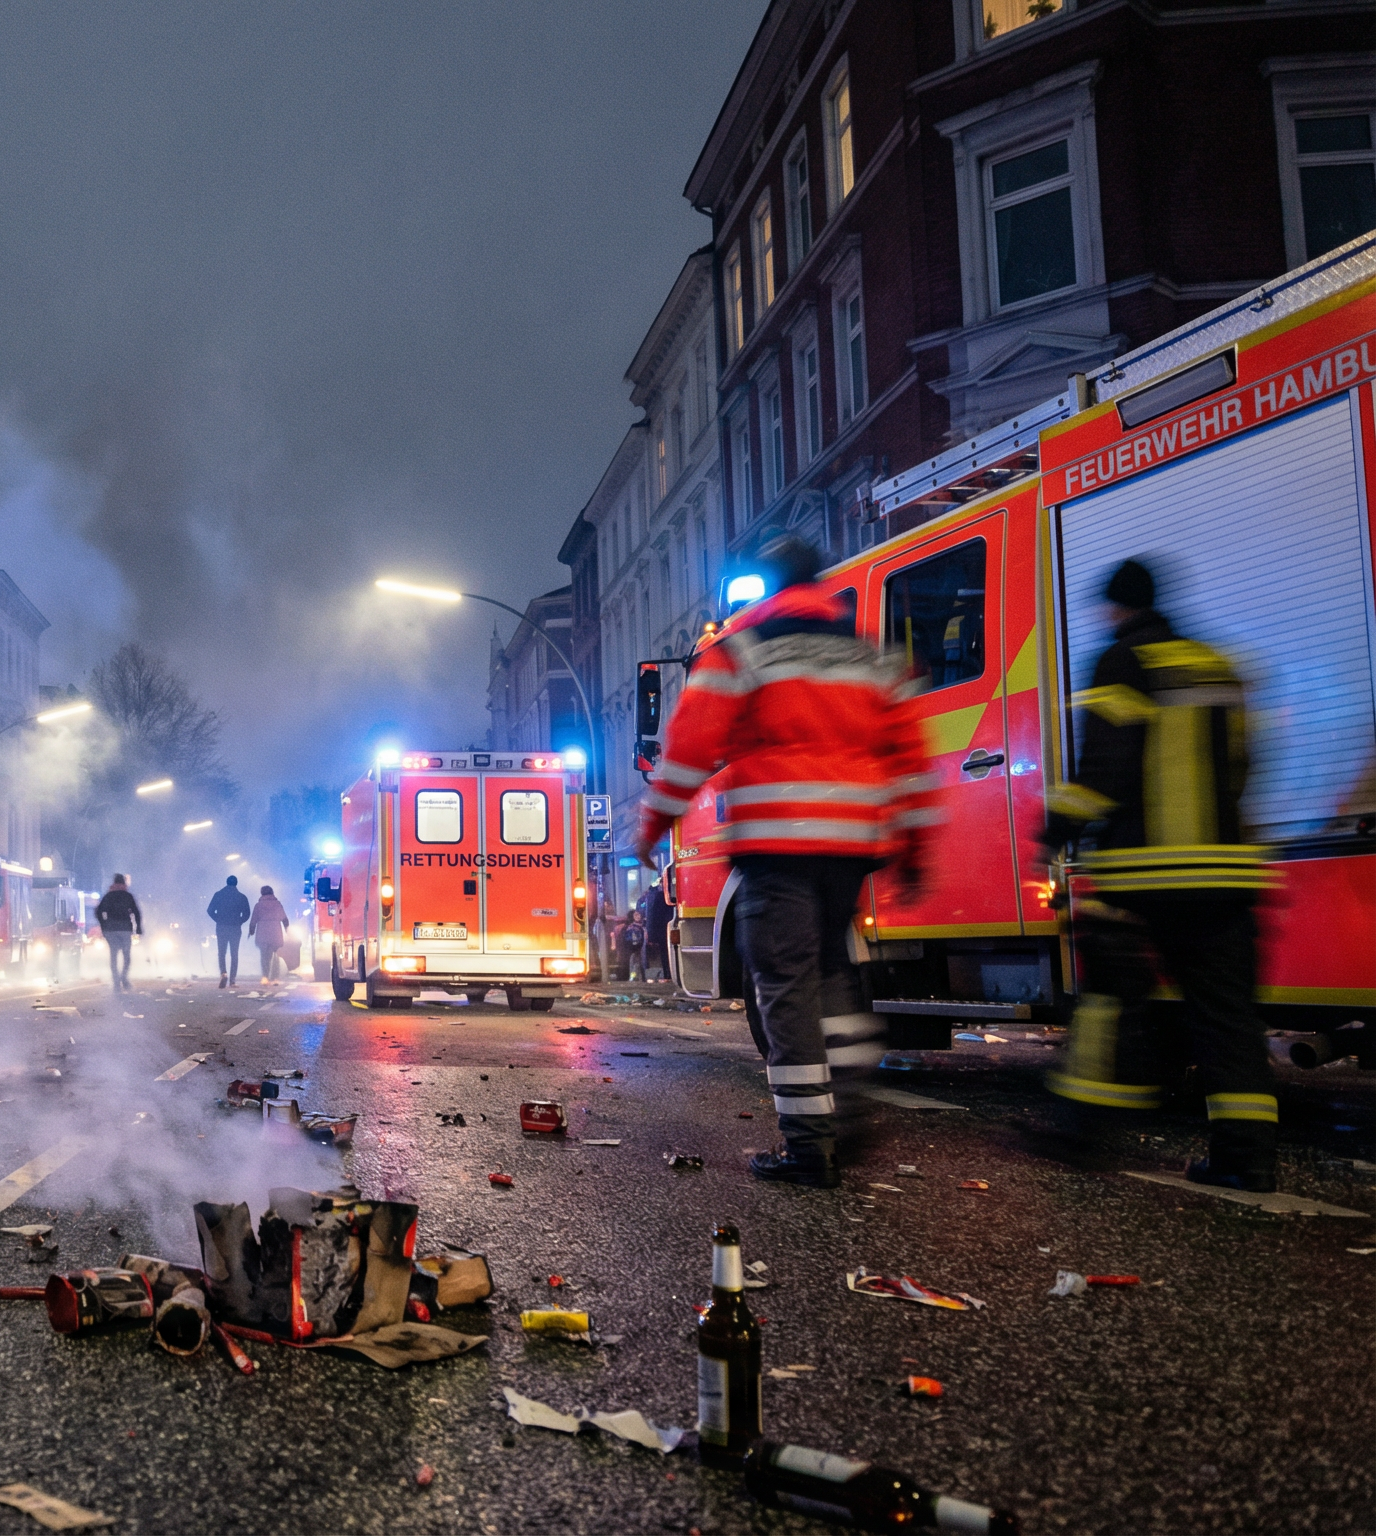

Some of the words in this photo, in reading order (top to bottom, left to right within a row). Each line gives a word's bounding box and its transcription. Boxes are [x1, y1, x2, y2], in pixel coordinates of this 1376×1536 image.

[1065, 397, 1243, 495] FEUERWEHR
[1254, 341, 1376, 419] HAMBU
[590, 800, 602, 816] P
[400, 853, 564, 868] RETTUNGSDIENST
